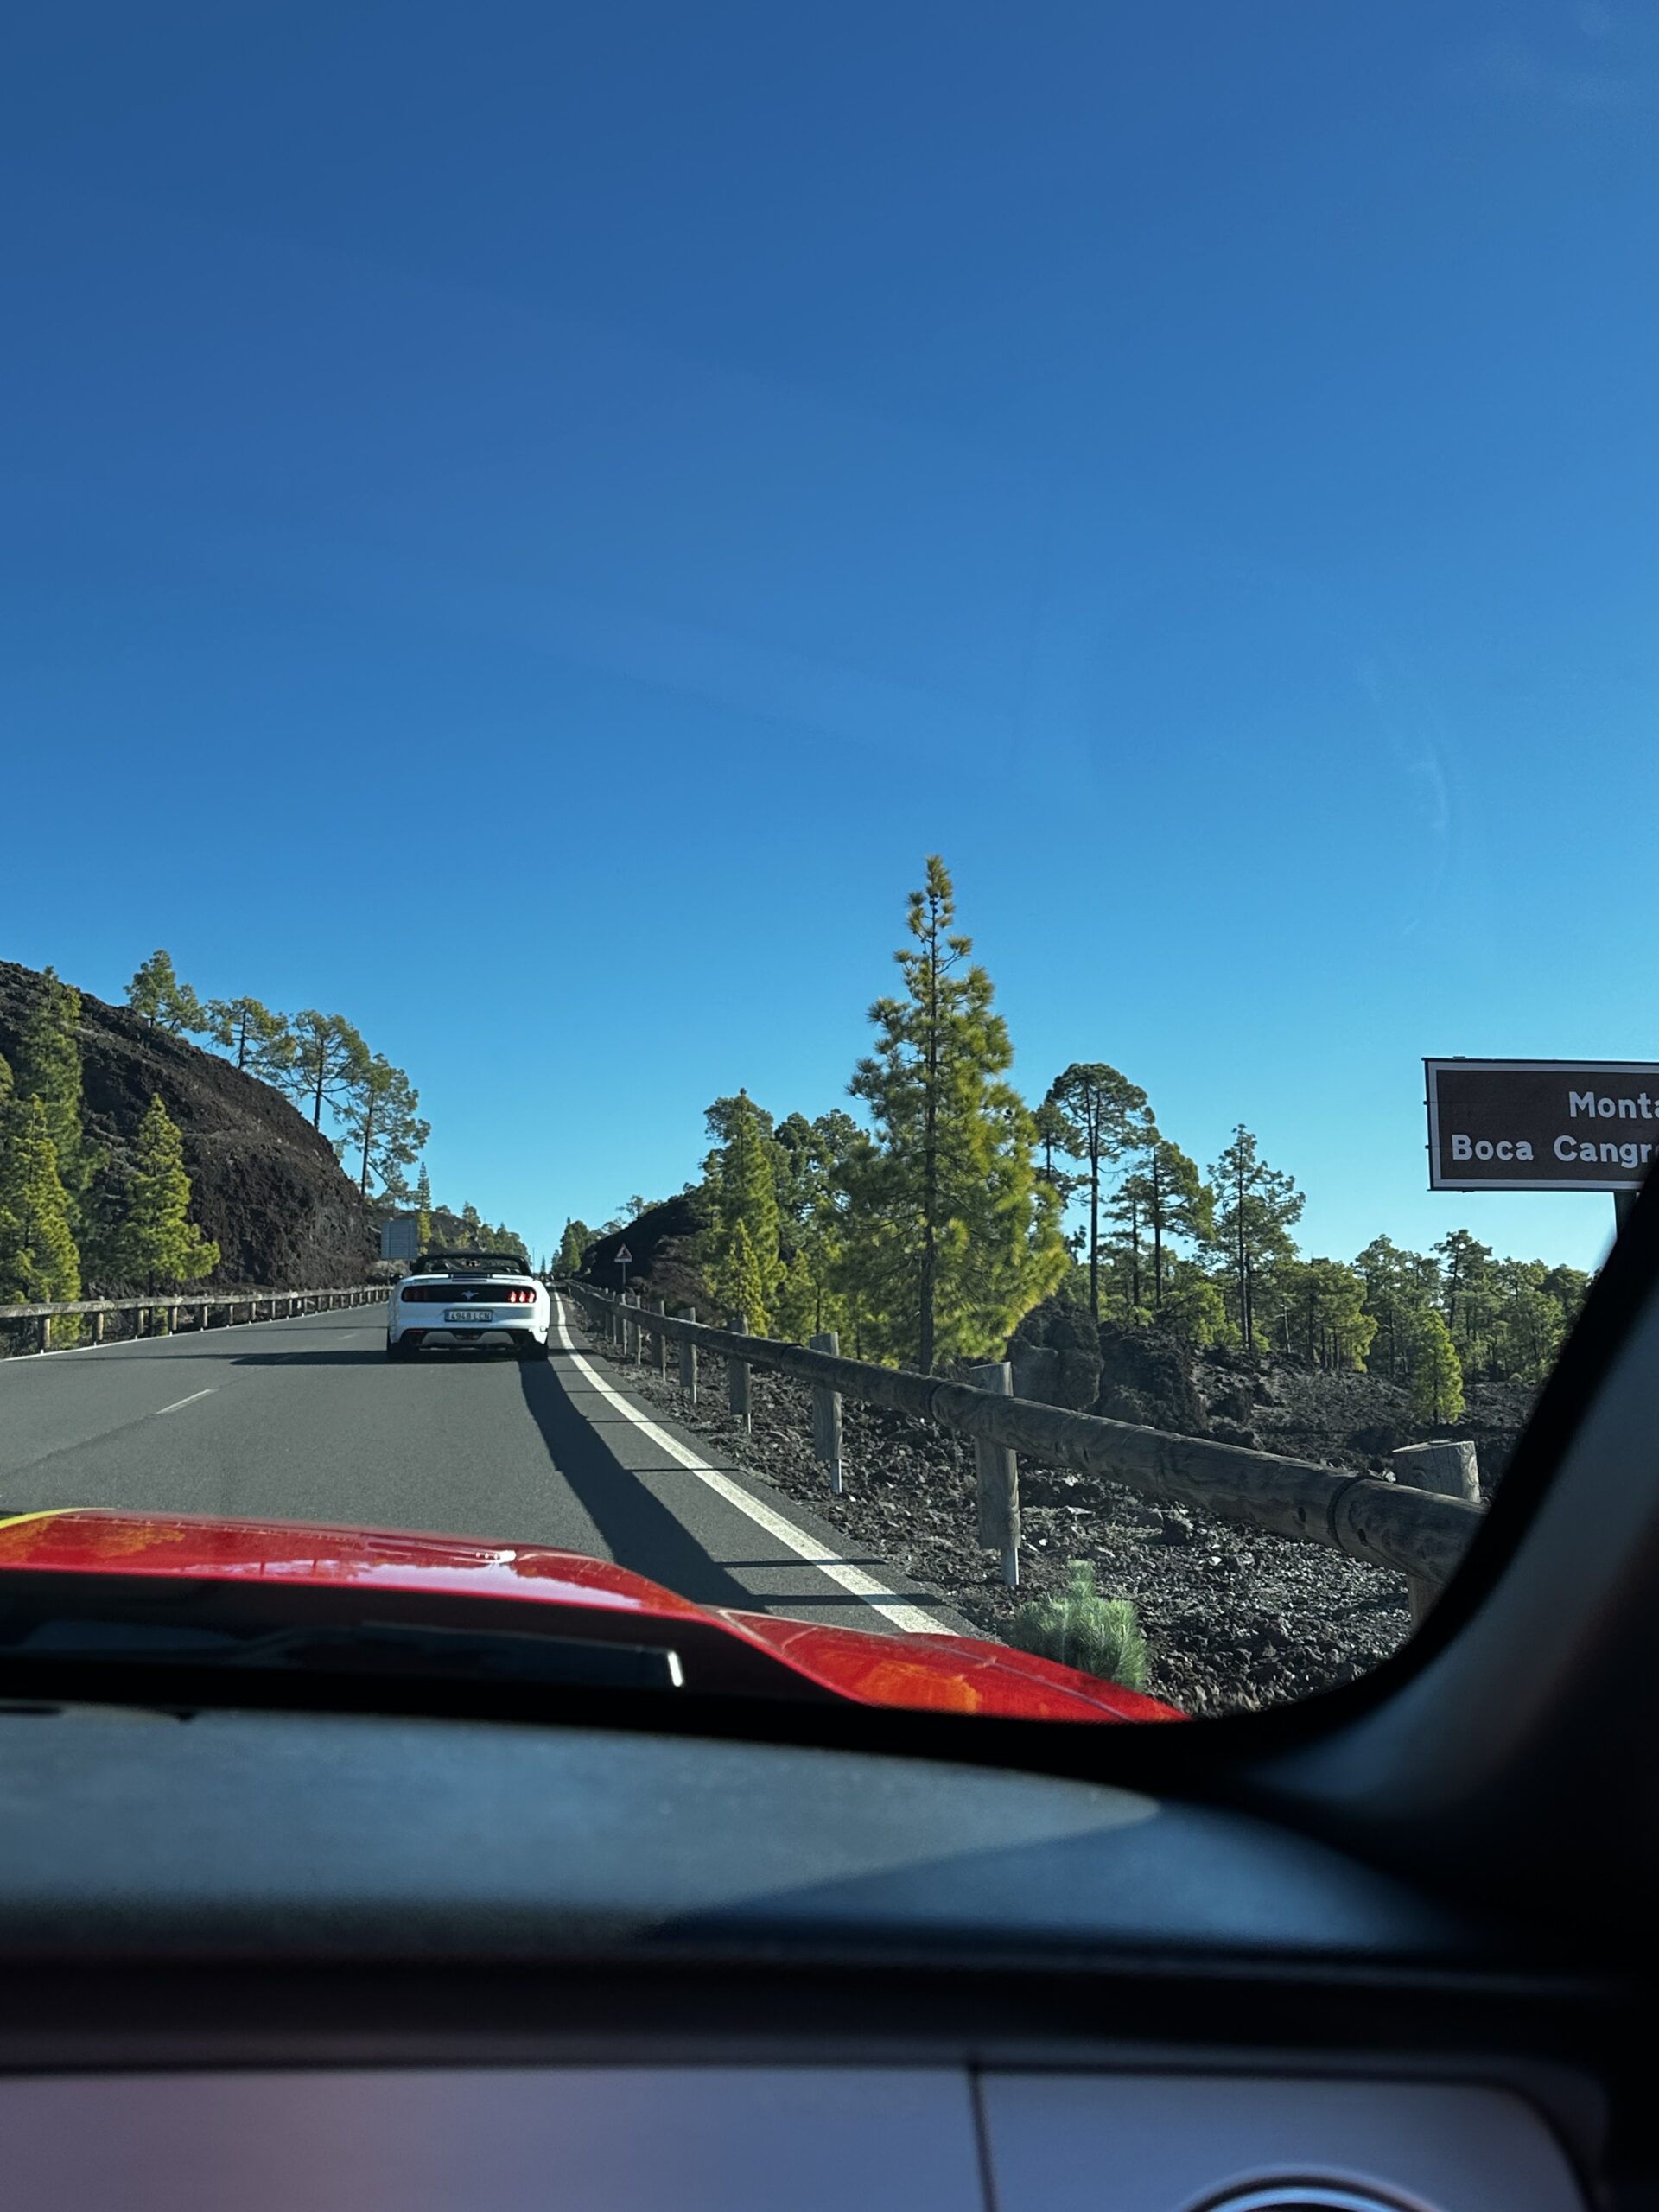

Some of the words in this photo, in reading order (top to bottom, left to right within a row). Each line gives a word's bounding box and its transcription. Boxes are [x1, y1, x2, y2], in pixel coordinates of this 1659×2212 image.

[1568, 1091, 1659, 1119] Mont
[1451, 1134, 1534, 1161] Boca
[1553, 1135, 1659, 1169] Cangr
